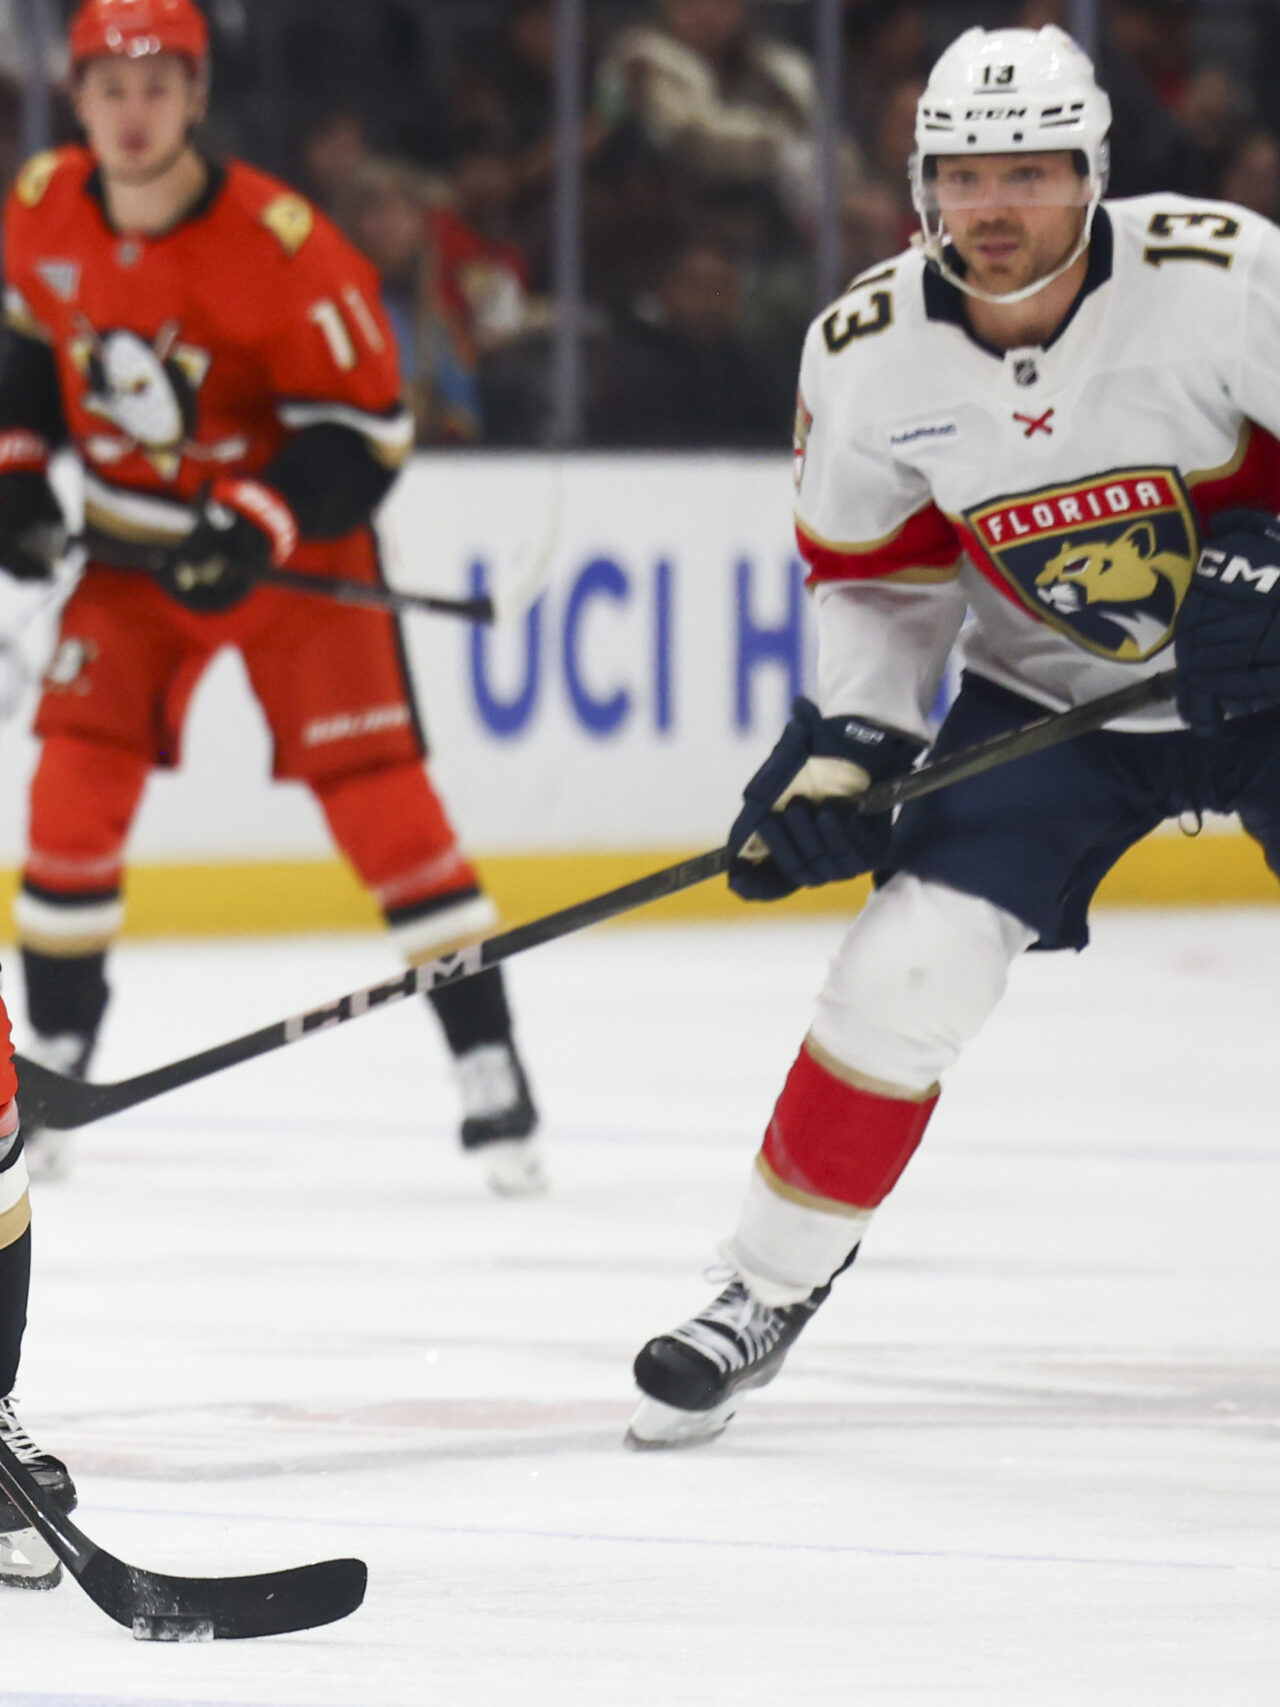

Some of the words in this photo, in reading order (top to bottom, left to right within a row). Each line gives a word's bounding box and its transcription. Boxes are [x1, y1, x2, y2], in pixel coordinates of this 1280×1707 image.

[982, 65, 1015, 85] 13
[964, 107, 1027, 121] CCM
[1142, 211, 1240, 271] 13
[986, 480, 1162, 543] FLORIDA
[1196, 548, 1280, 594] CM
[470, 555, 673, 738] UCI
